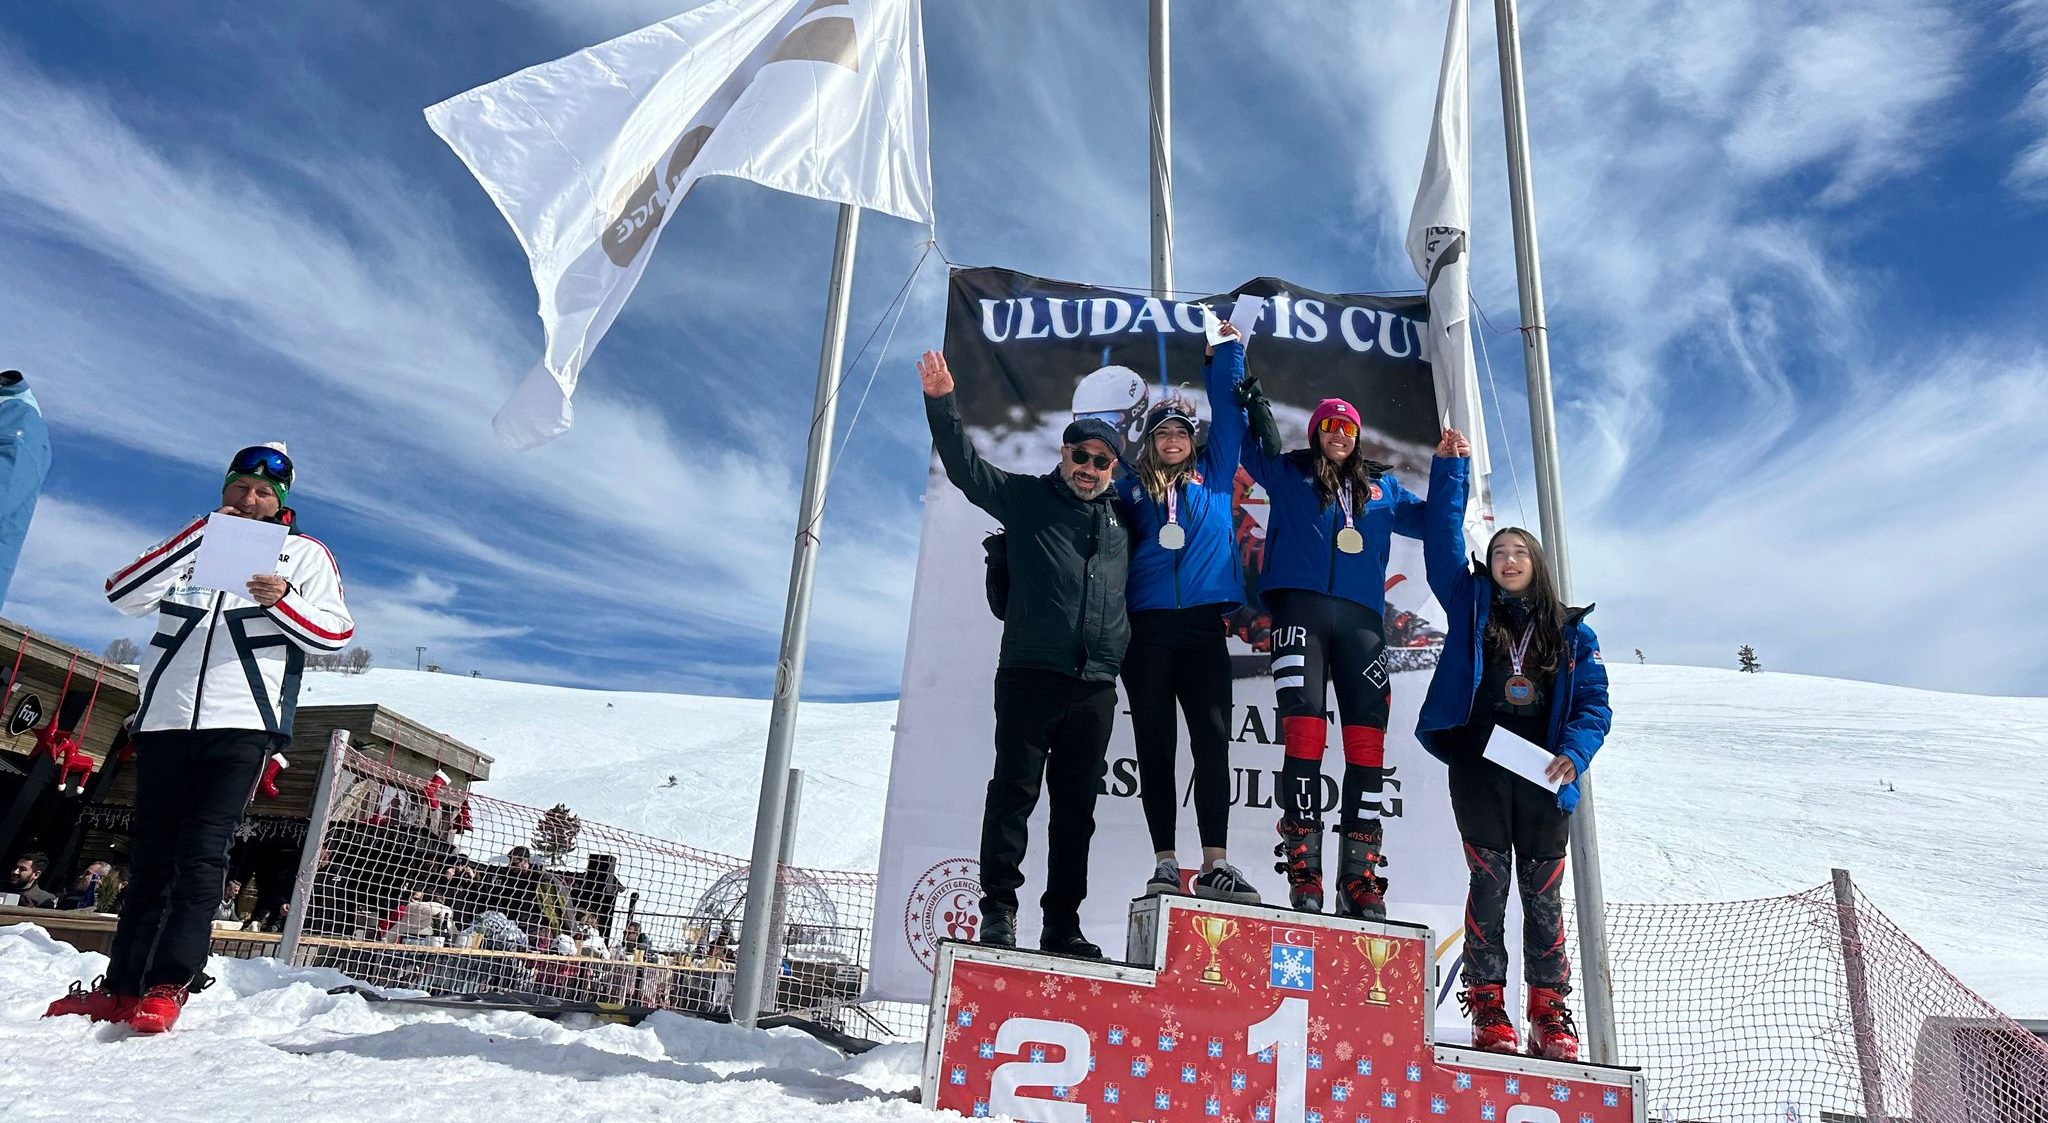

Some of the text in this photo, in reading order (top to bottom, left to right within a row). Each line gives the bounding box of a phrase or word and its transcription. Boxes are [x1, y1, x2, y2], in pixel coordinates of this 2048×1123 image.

[1271, 625, 1307, 652] TUR
[988, 1017, 1091, 1123] 2
[1247, 997, 1308, 1123] 1
